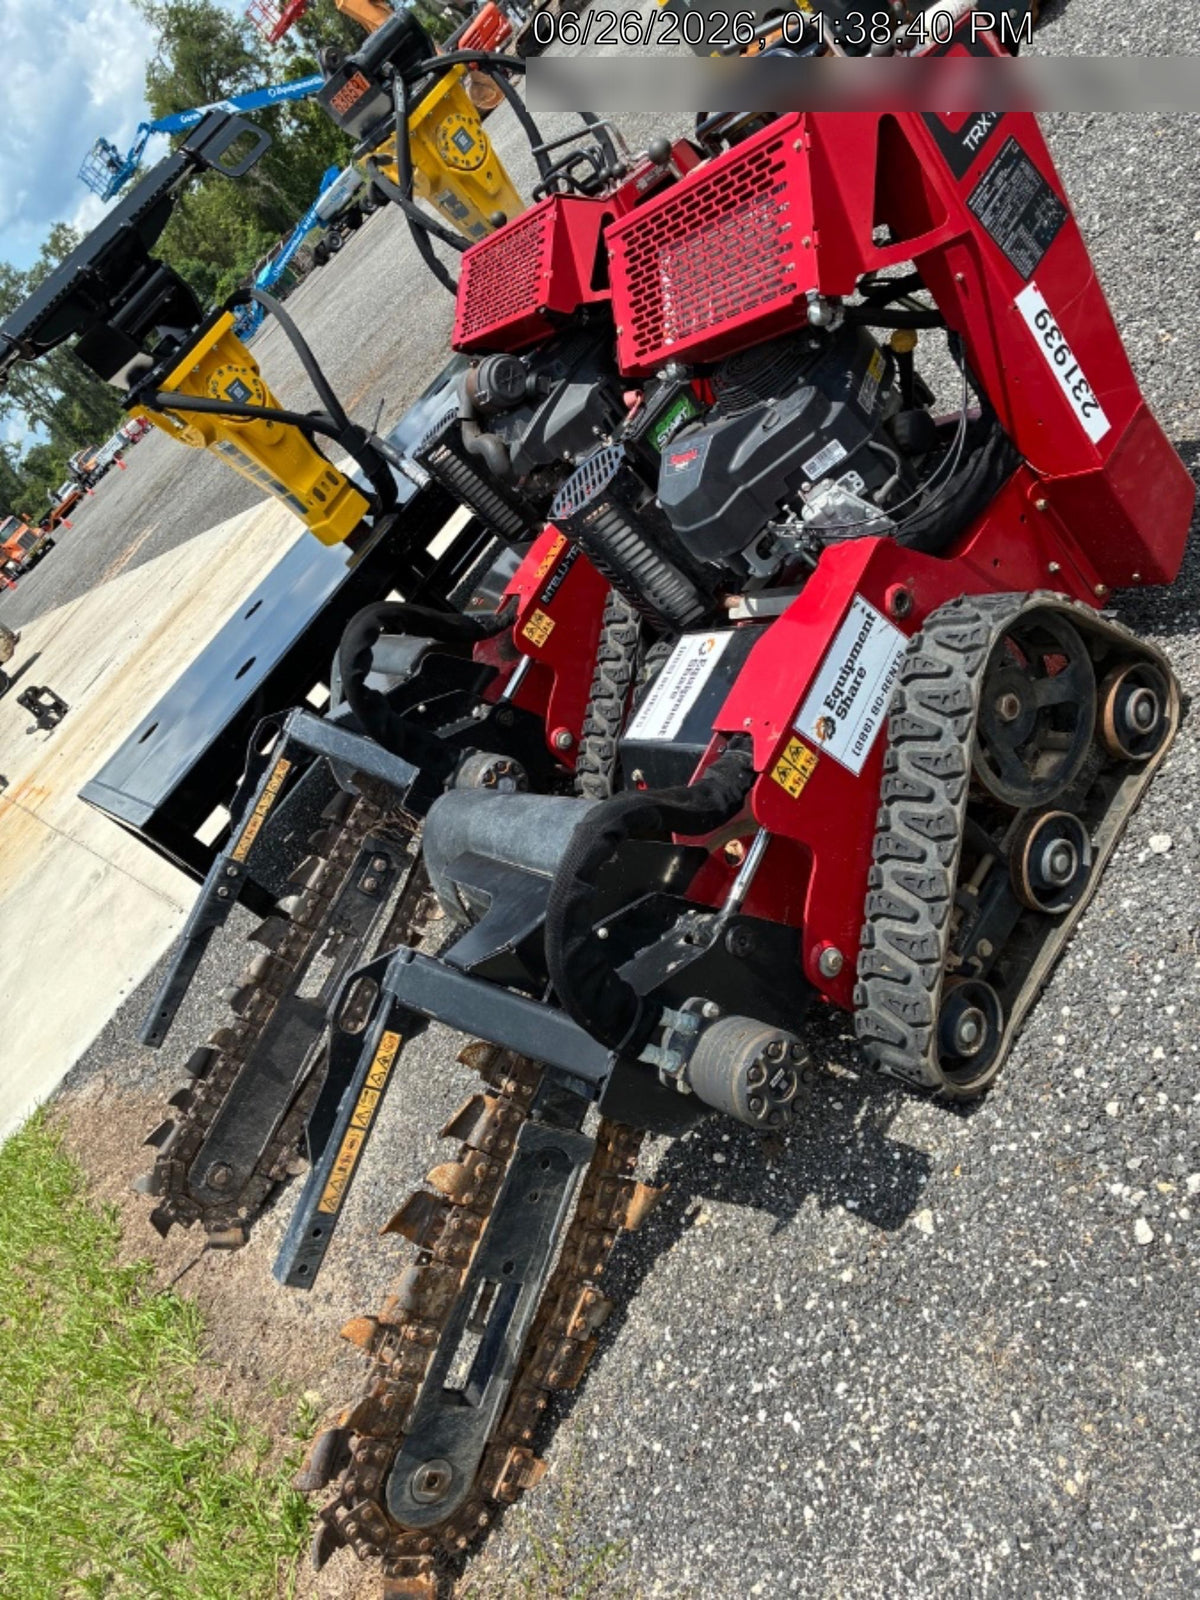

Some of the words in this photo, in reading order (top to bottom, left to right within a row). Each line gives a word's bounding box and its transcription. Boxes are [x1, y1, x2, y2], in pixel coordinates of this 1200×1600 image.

[962, 111, 1000, 154] TRX-
[1034, 308, 1100, 419] 231939
[822, 609, 878, 711] Equipment
[871, 650, 906, 714] 80-RENTS
[836, 665, 868, 721] Share
